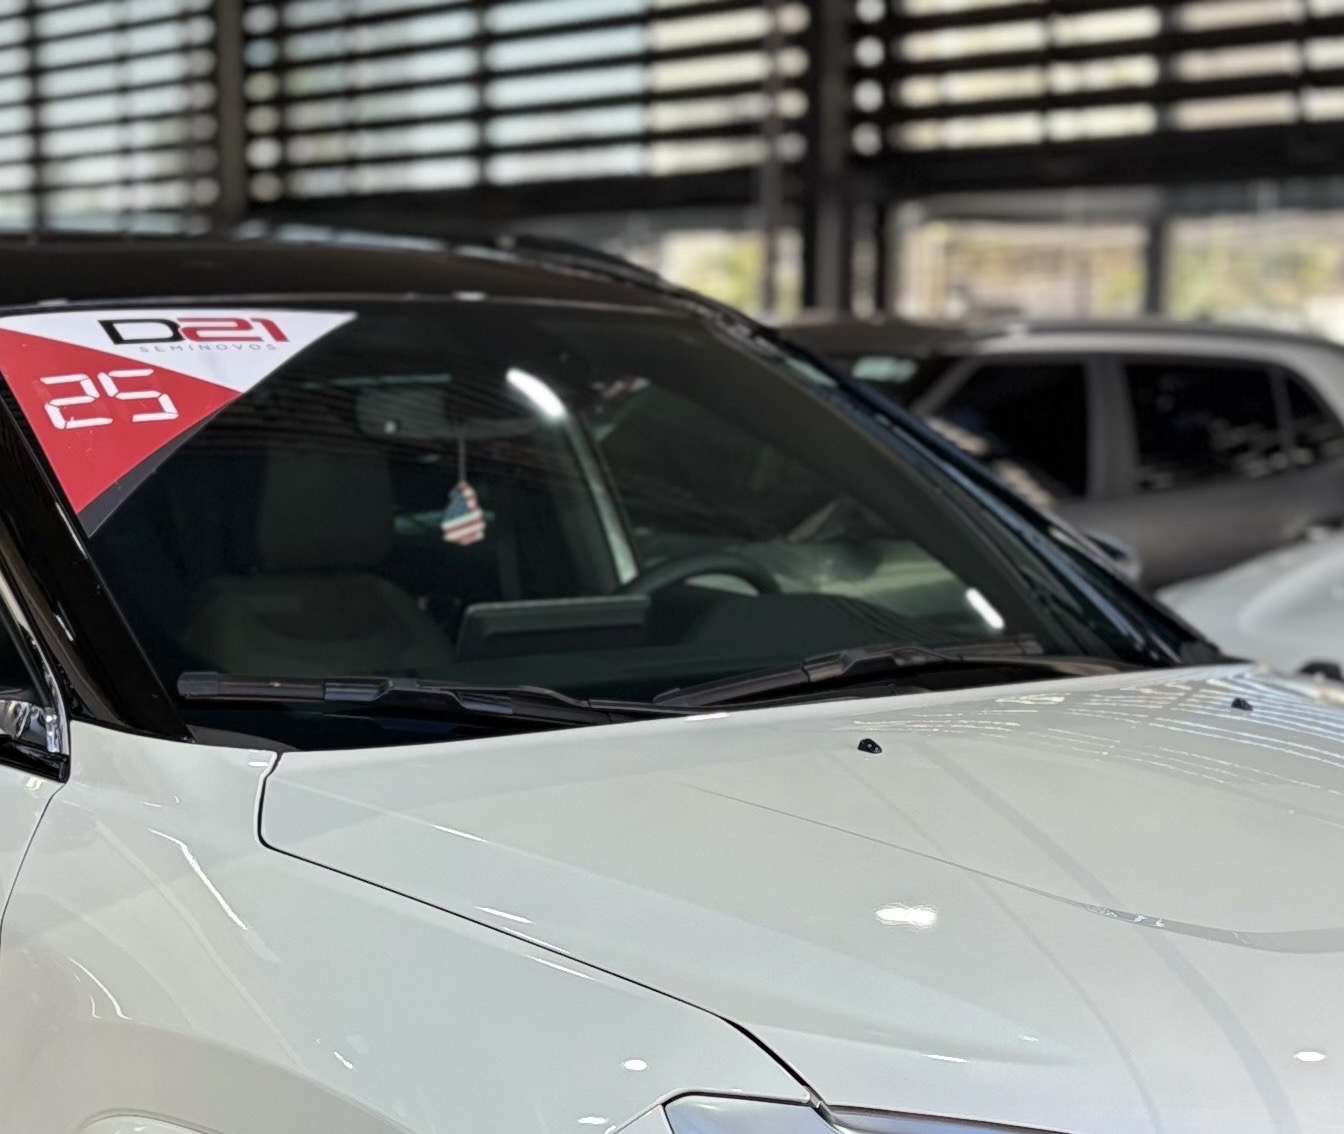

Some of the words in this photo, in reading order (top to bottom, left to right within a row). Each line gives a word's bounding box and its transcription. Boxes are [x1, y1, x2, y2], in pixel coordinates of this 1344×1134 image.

[98, 318, 289, 345] D21
[138, 343, 277, 353] SEMINOVOS
[40, 368, 179, 430] 25
